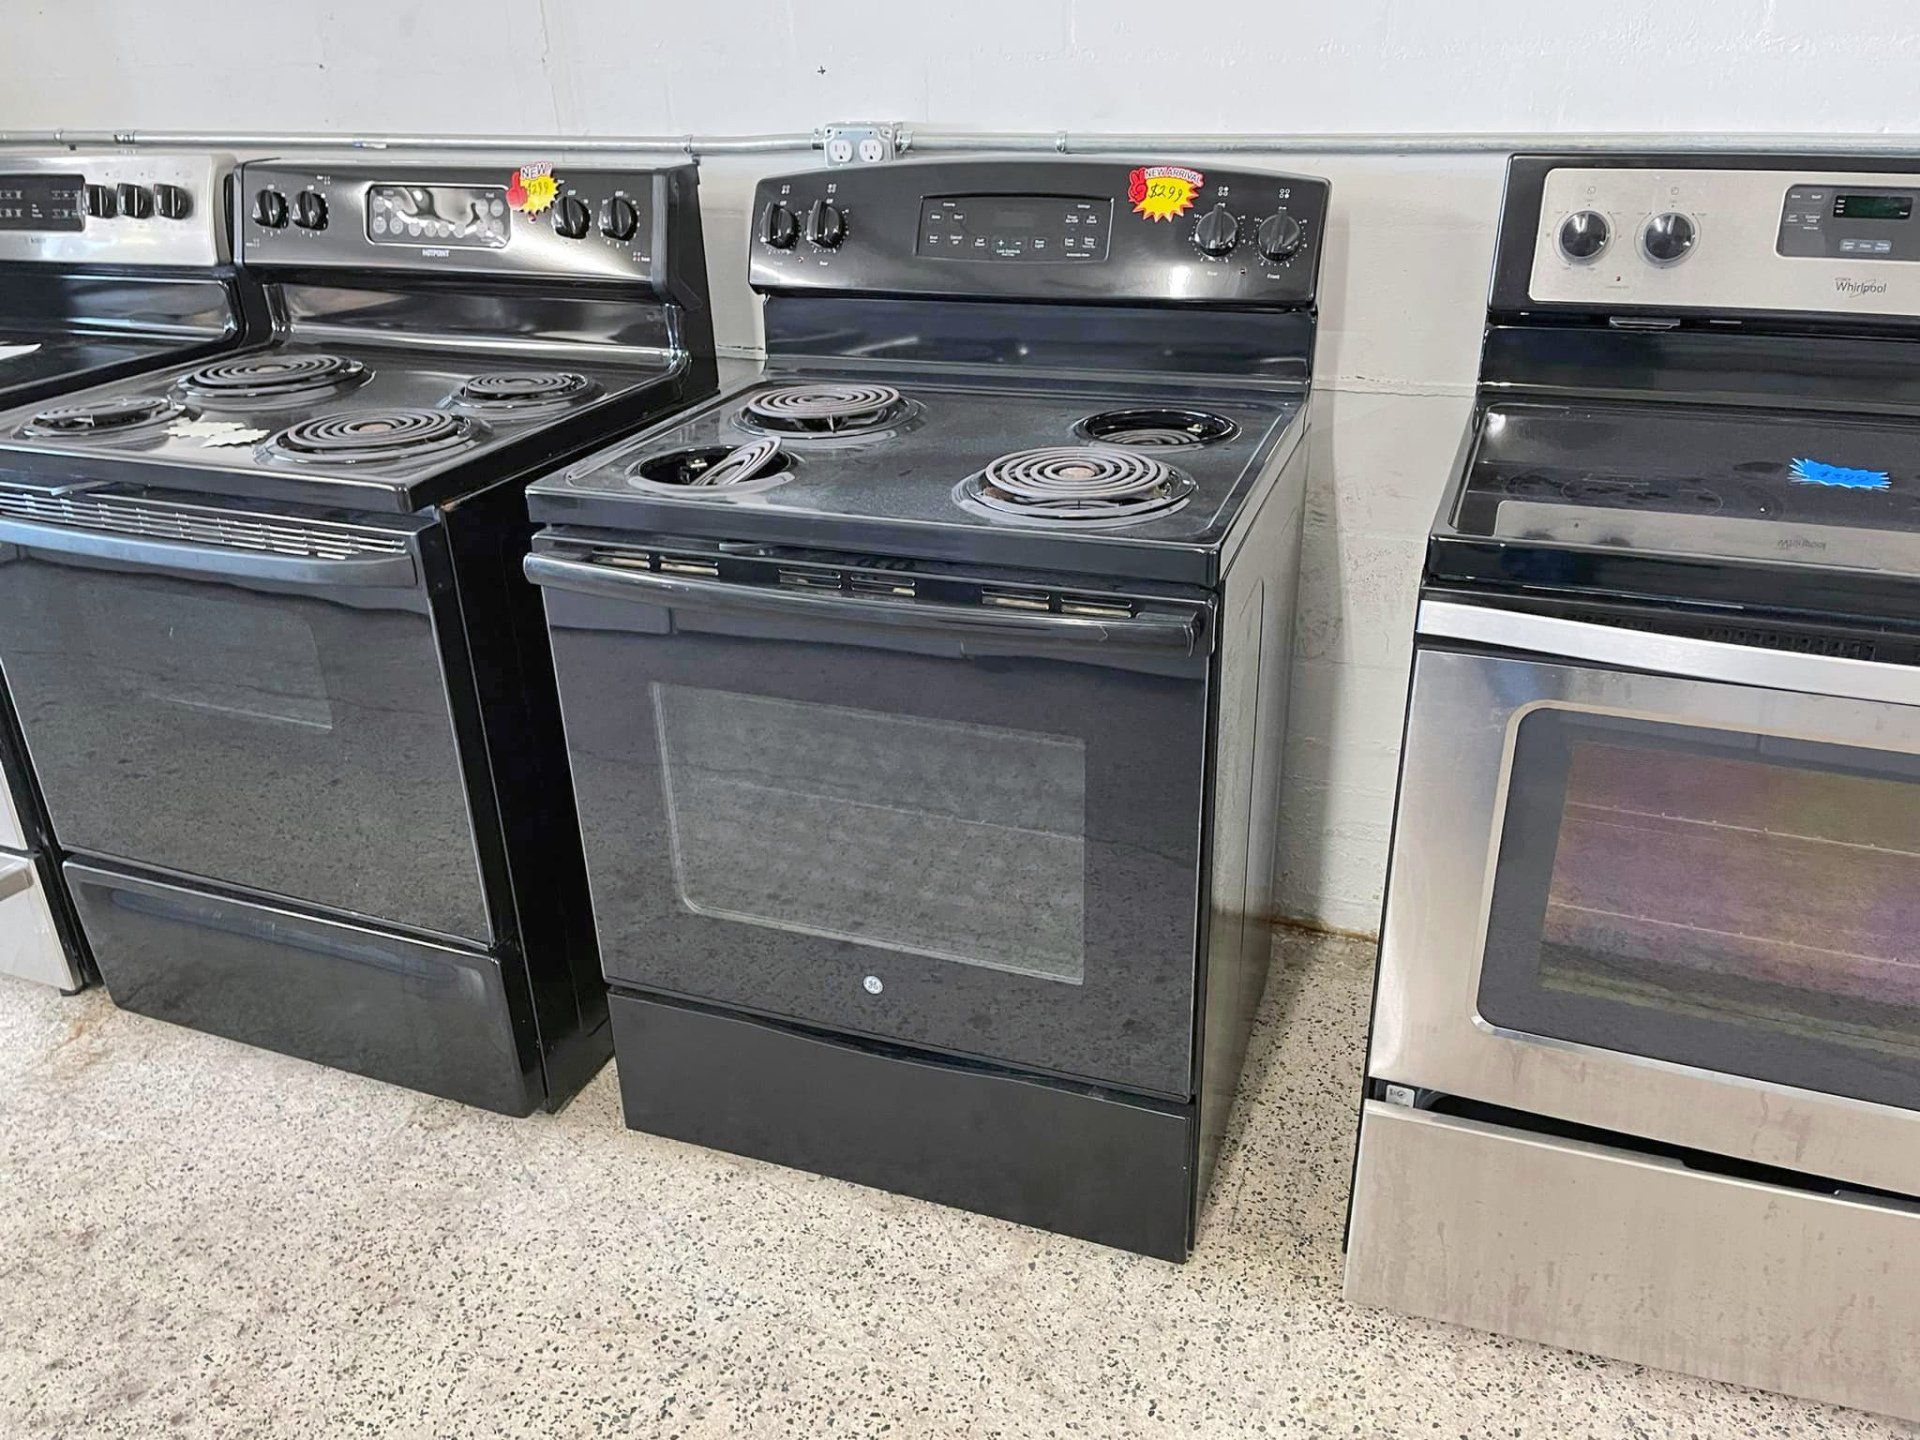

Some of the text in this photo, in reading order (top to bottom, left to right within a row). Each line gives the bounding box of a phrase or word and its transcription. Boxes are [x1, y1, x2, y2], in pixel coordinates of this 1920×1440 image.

[1146, 168, 1201, 183] NEW ARRIVAL
[1149, 183, 1183, 202] $299
[1835, 282, 1887, 295] Whirlpool
